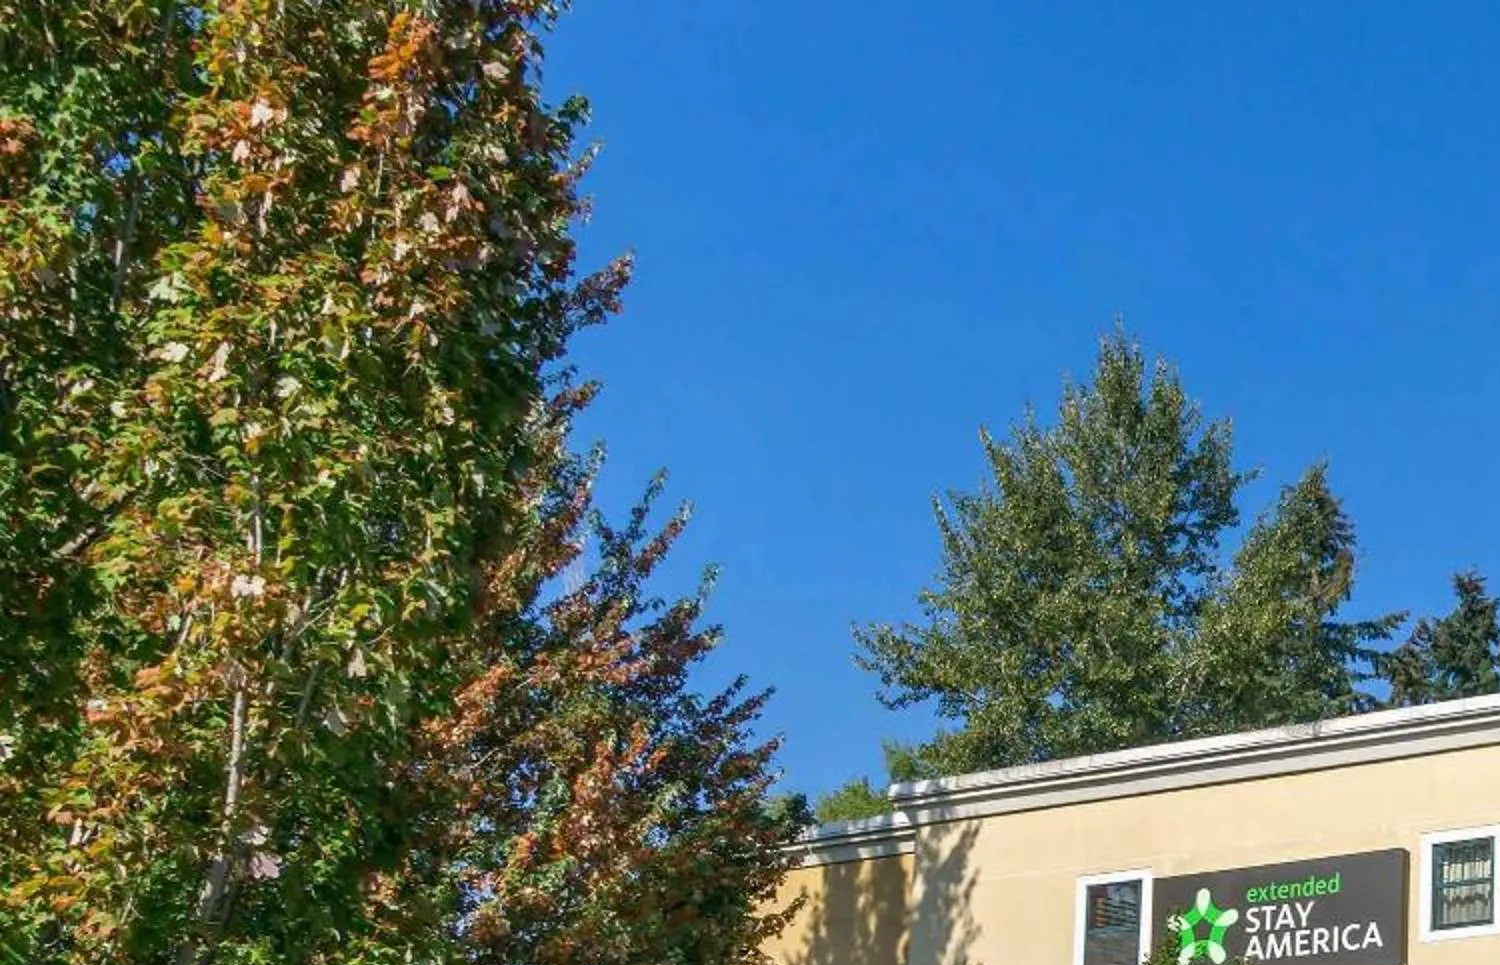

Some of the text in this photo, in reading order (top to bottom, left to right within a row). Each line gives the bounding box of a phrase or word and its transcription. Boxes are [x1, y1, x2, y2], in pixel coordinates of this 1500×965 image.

[1246, 871, 1341, 903] extended
[1244, 900, 1315, 933] STAY
[1243, 921, 1384, 961] AMERICA
